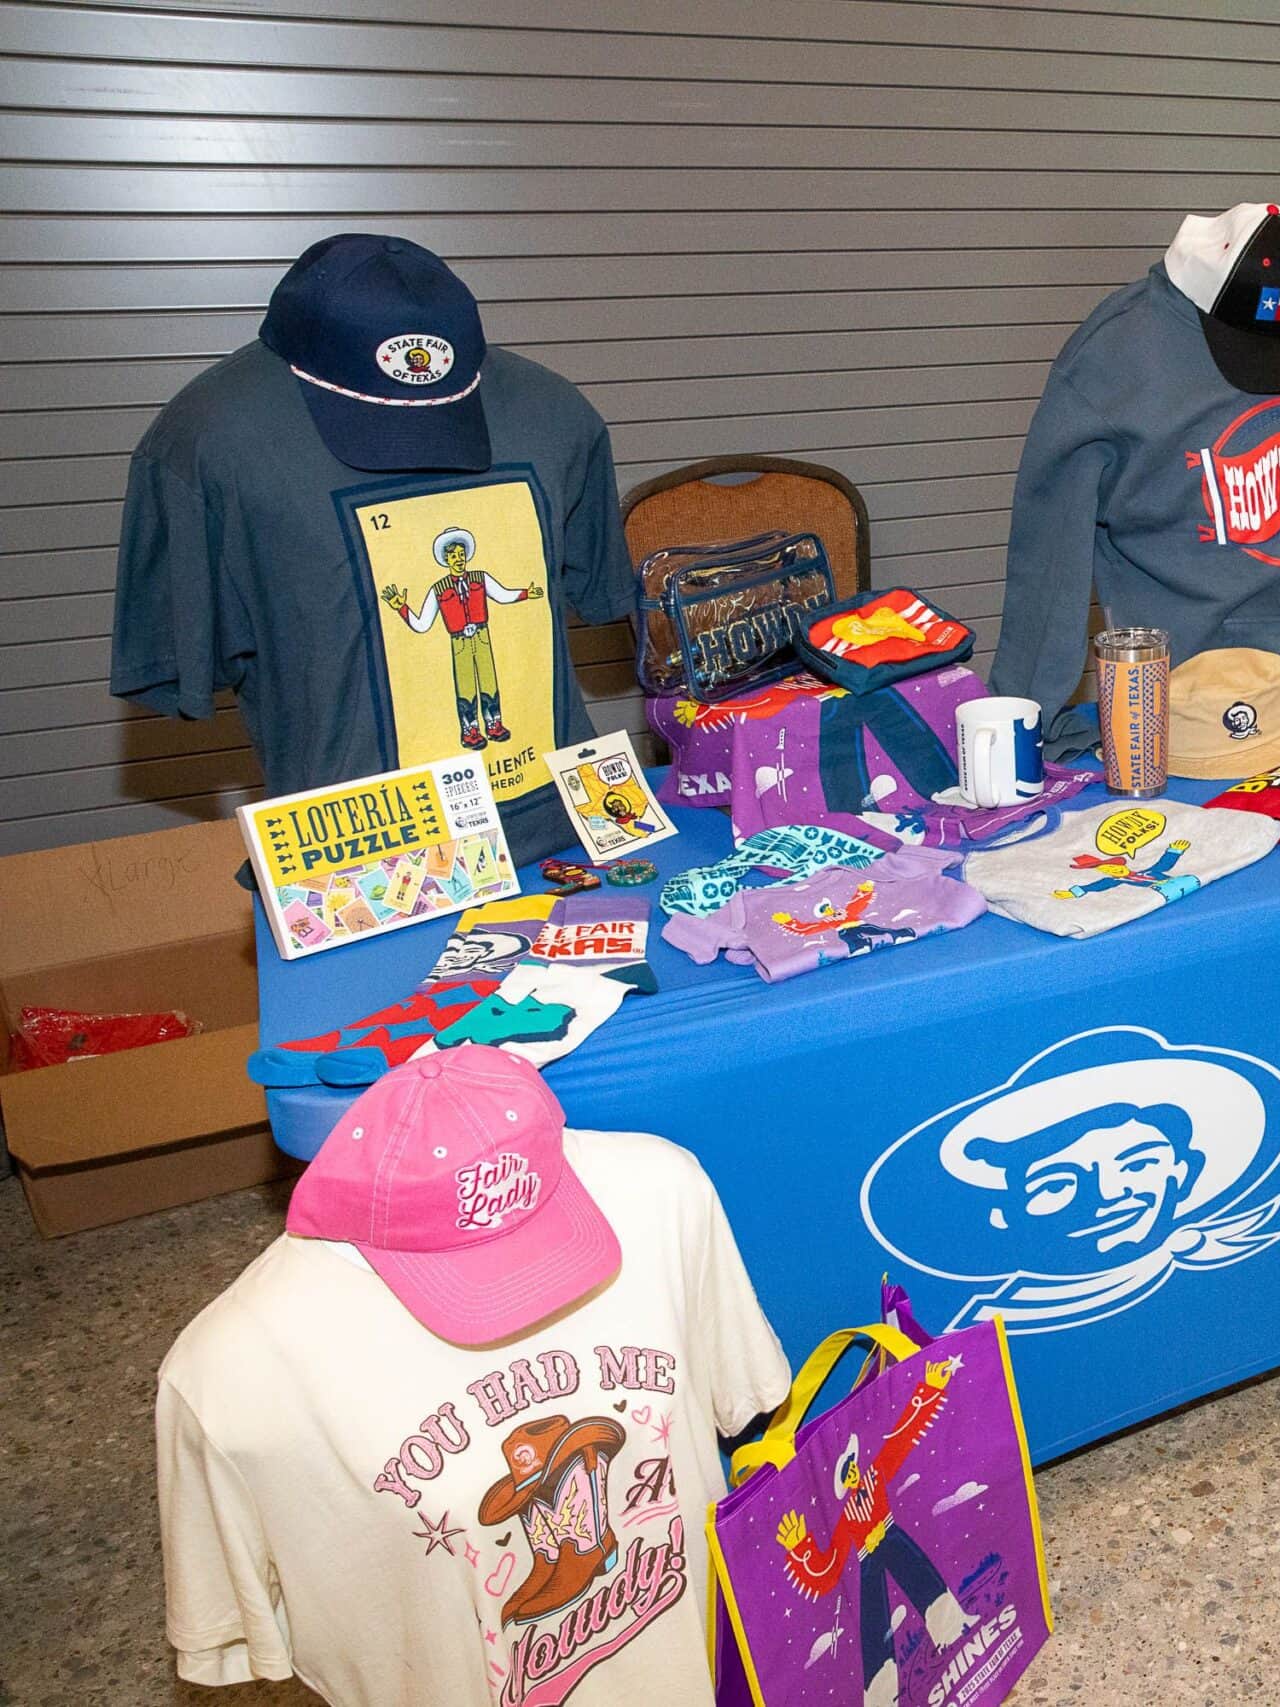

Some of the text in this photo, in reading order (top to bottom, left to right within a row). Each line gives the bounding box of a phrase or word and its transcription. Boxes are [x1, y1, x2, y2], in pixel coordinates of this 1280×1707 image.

[387, 338, 448, 354] STATE FAIR
[392, 369, 442, 382] OF TEXAS
[370, 513, 391, 531] 12
[698, 590, 830, 674] HOWD
[1128, 669, 1139, 706] TEXAS
[1130, 722, 1140, 749] FAIR
[441, 768, 474, 785] 300
[488, 745, 537, 778] LIENTE
[1131, 752, 1141, 788] STATE
[678, 771, 733, 797] EXA
[288, 784, 414, 849] LOTERÍA
[1101, 810, 1150, 845] HOWDY
[301, 824, 421, 871] PUZZLE
[1119, 820, 1160, 849] FOLKS!
[575, 922, 635, 937] FAIR
[458, 1154, 524, 1200] Fair
[458, 1174, 538, 1228] Lady
[374, 1345, 676, 1508] YOU HAD ME
[927, 1604, 1017, 1706] SHINES
